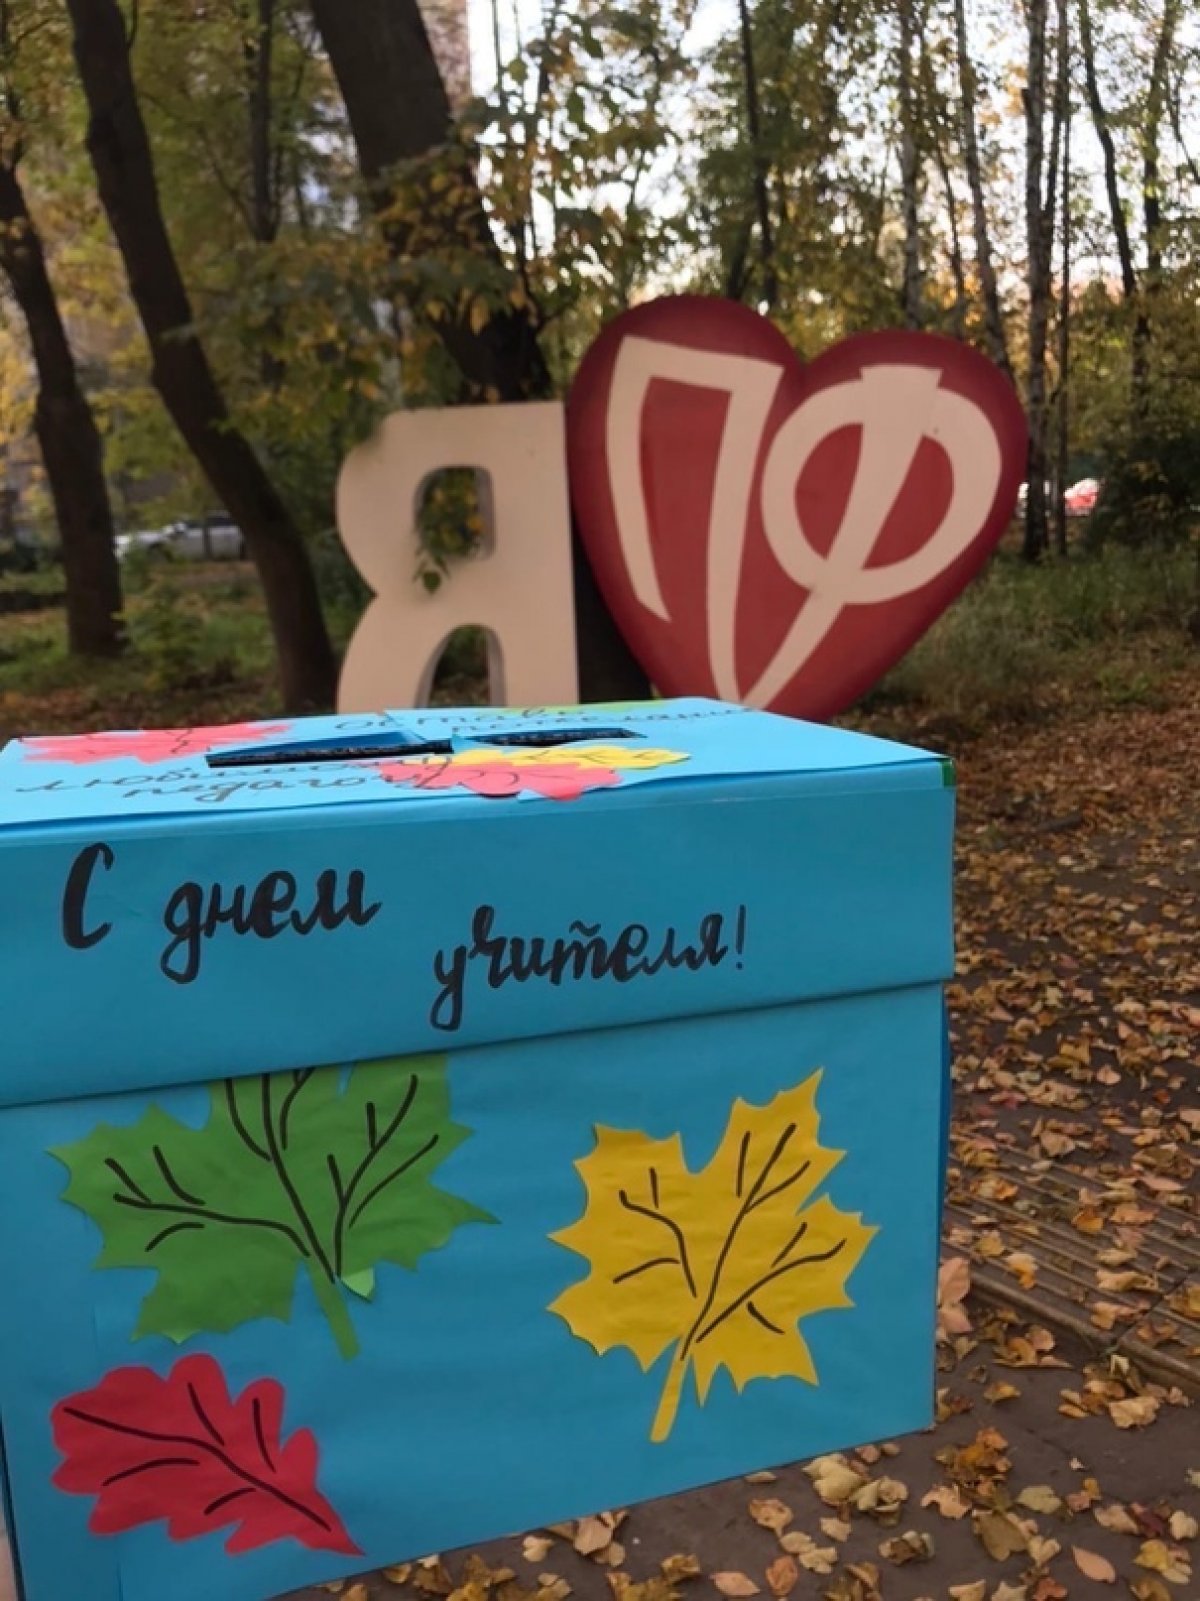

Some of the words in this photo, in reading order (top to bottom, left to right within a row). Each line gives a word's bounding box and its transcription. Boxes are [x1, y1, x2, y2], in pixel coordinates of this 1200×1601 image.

[335, 401, 579, 712] Я
[606, 335, 1002, 712] ПФ
[62, 842, 114, 949] С
[160, 867, 382, 985] днем
[429, 904, 747, 1032] учителя!
